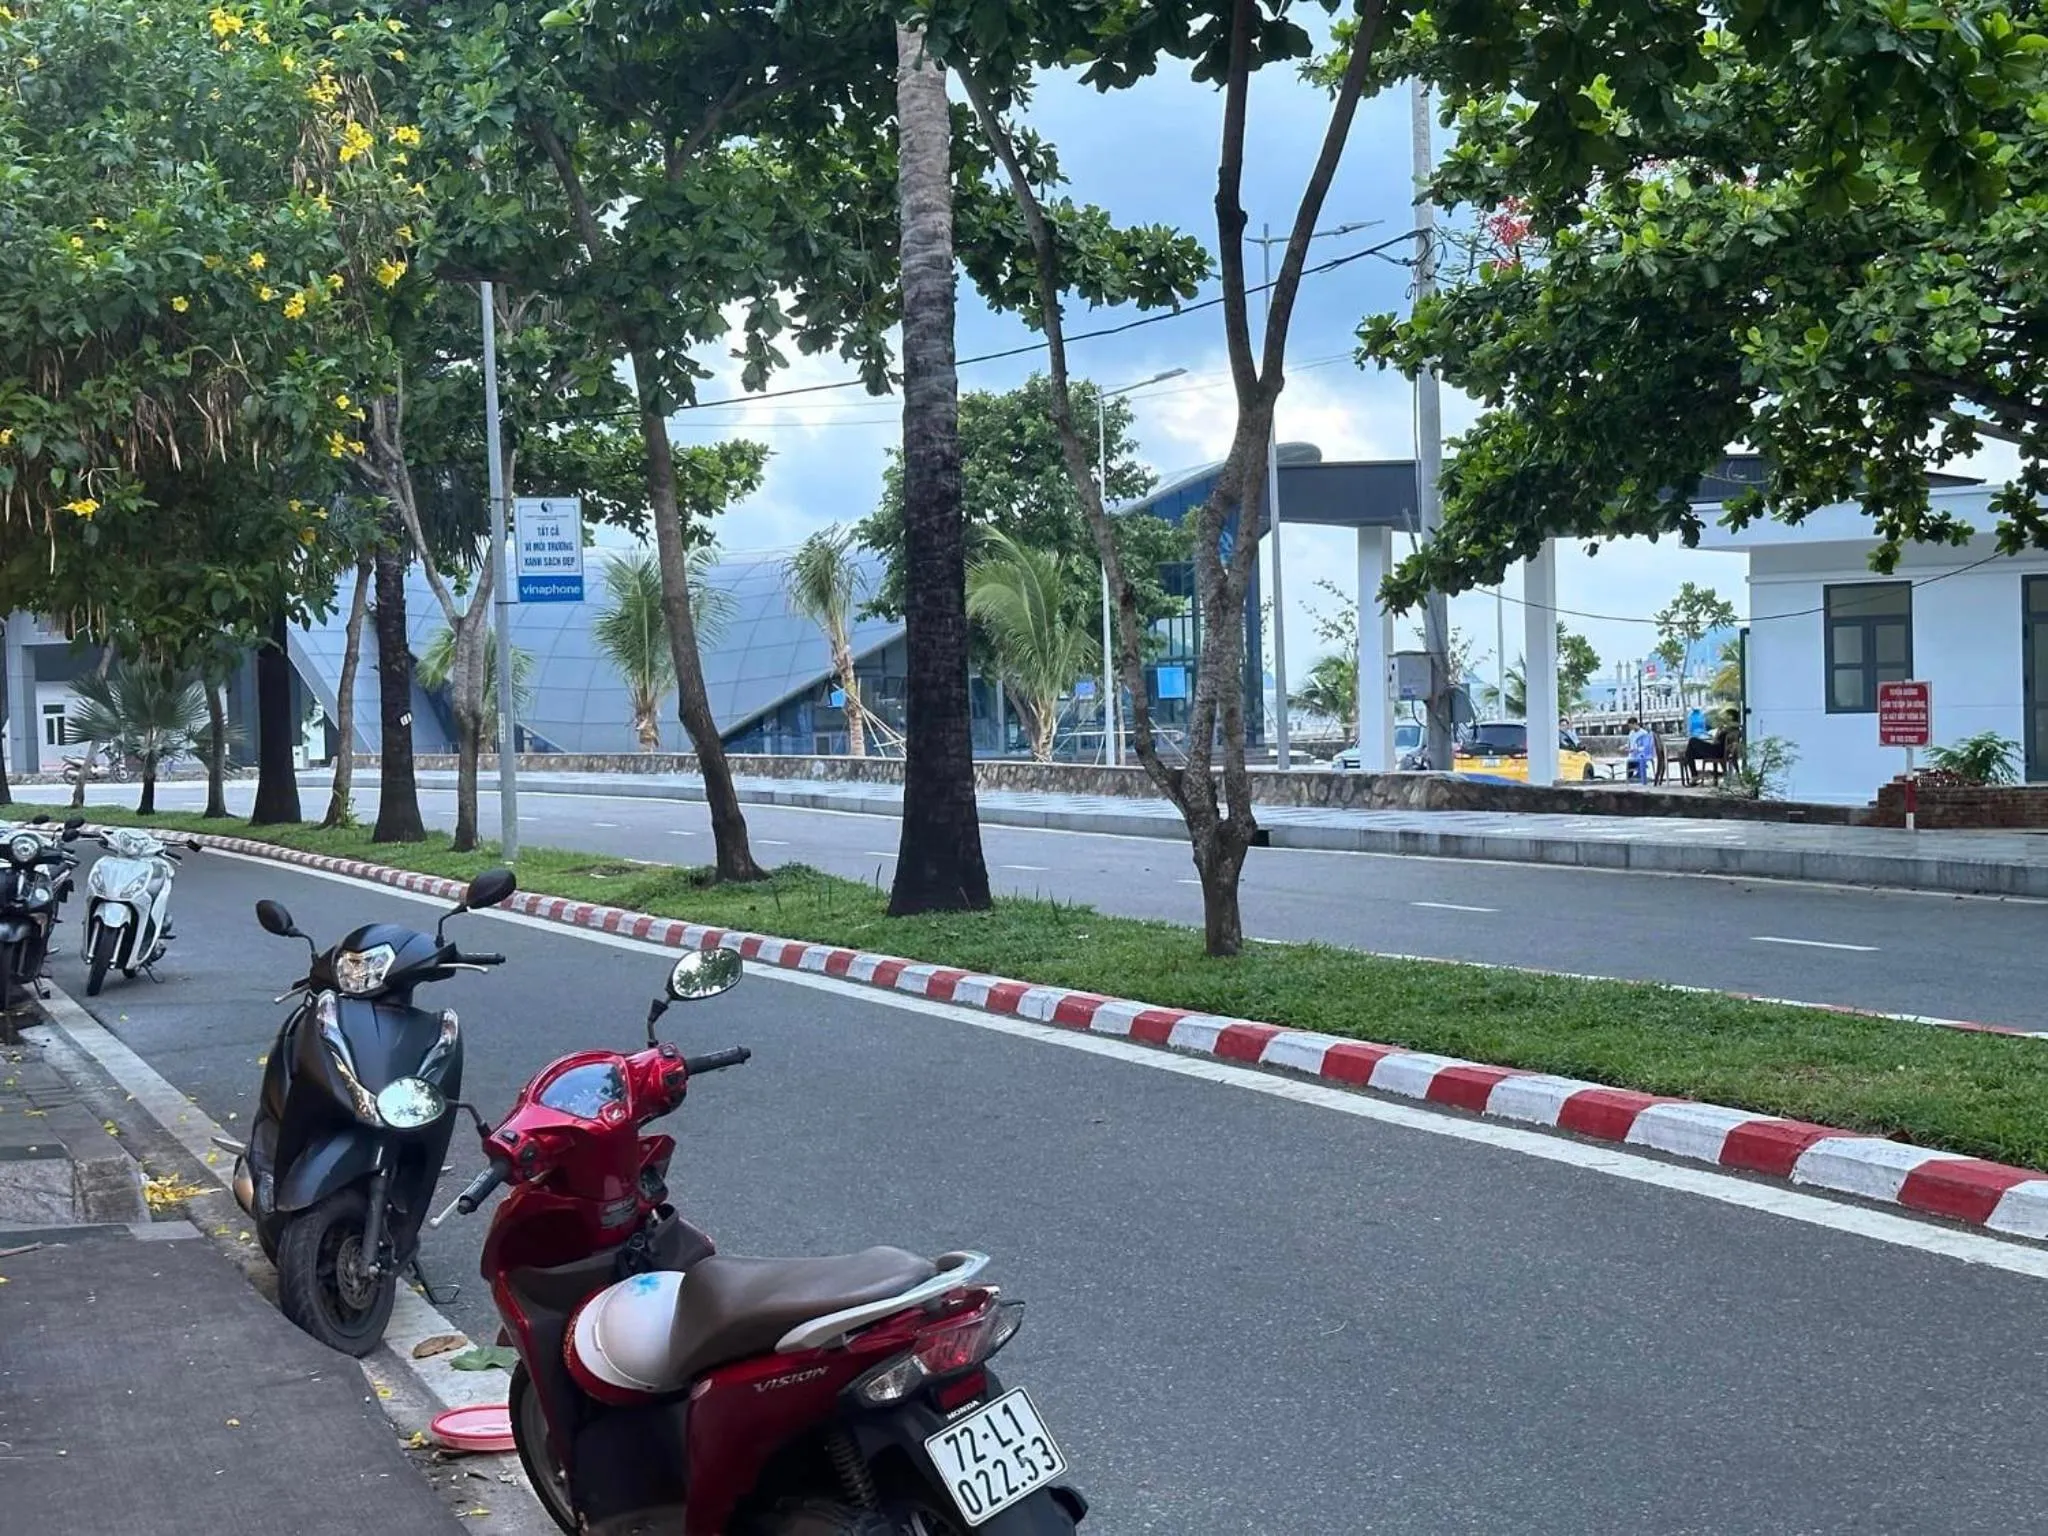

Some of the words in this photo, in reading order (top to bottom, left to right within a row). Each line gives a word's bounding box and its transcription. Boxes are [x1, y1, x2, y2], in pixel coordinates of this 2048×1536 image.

[522, 584, 581, 595] vinaphone
[753, 1366, 829, 1392] VISION
[946, 1400, 981, 1420] HONDA
[958, 1436, 1056, 1515] 022.53
